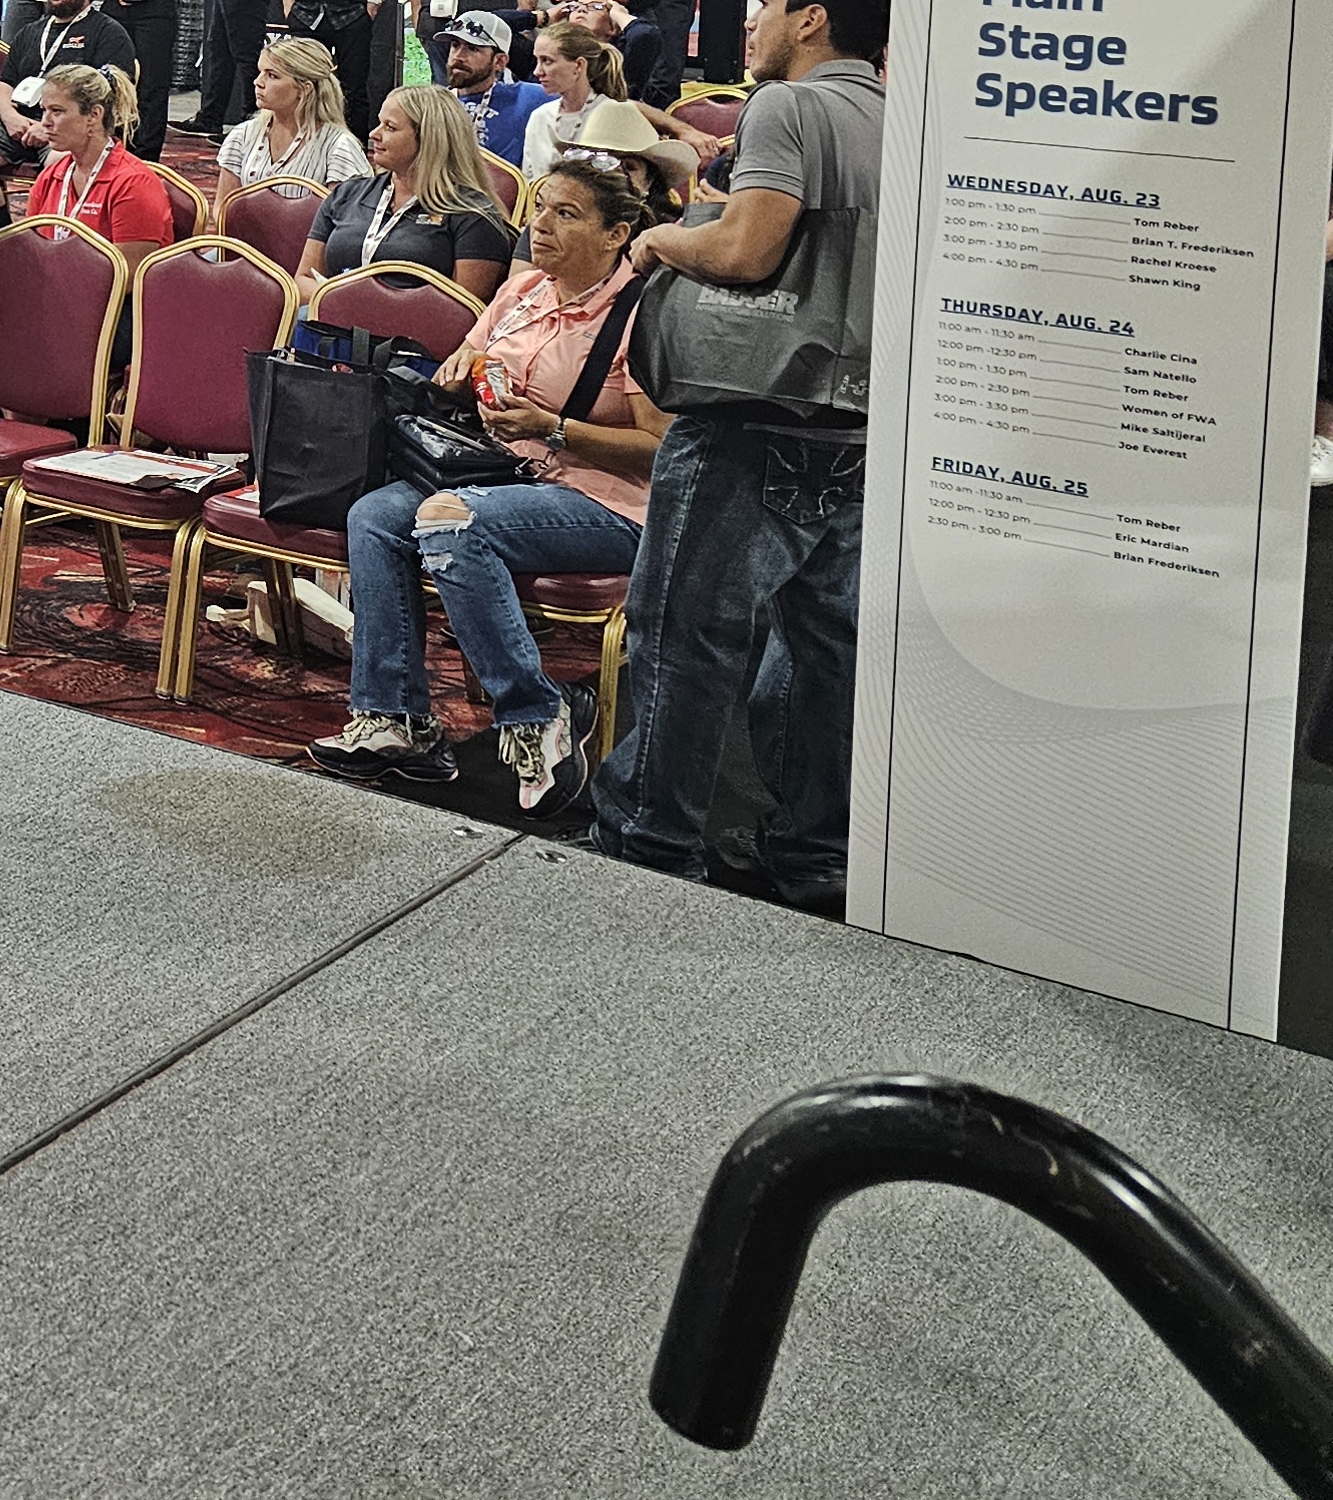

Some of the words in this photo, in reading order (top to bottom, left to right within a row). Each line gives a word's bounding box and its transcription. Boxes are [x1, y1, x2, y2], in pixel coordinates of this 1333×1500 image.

[977, 22, 1127, 71] Stage
[975, 72, 1219, 125] Speakers
[947, 174, 1074, 201] WEDNESDAY,
[1081, 188, 1129, 204] AUG.
[1136, 193, 1160, 207] 23
[944, 216, 966, 225] 2:00
[969, 220, 987, 228] pm
[997, 222, 1019, 231] 2:30
[1021, 226, 1039, 234] pm
[1132, 237, 1163, 247] Brian
[1167, 241, 1177, 249] T.
[1181, 242, 1254, 258] Frederiksen
[945, 197, 965, 206] 1:00
[968, 202, 986, 210] pm
[996, 203, 1015, 212] 1:30
[1018, 207, 1036, 215] pm
[1134, 218, 1160, 228] Tom
[1163, 221, 1199, 232] Reber
[942, 234, 965, 244] 3:00
[968, 238, 986, 247] pm
[996, 240, 1017, 249] 3:30
[1020, 244, 1038, 252] pm
[1131, 256, 1171, 267] Rachel
[1175, 261, 1217, 273] Kroese
[942, 252, 965, 261] 4:00
[968, 256, 986, 264] pm
[996, 258, 1018, 268] 4:30
[1021, 263, 1039, 271] pm
[1129, 275, 1169, 286] Shawn
[1173, 280, 1201, 292] King
[941, 298, 1048, 326] THURSDAY,
[1055, 313, 1102, 331] AUG.
[1109, 320, 1134, 335] 24
[937, 339, 963, 350] 12:00
[966, 344, 984, 353] pm
[1019, 352, 1037, 361] pm
[1124, 366, 1149, 377] Sam
[1153, 370, 1197, 384] Natello
[938, 321, 962, 331] 11:00
[964, 326, 982, 334] am
[991, 328, 1014, 339] 11:30
[1018, 333, 1035, 341] am
[1124, 347, 1167, 361] Charlie
[1170, 354, 1197, 365] Cina
[935, 375, 957, 385] 2:00
[960, 380, 978, 389] pm
[987, 383, 1009, 394] 2:30
[1012, 388, 1030, 397] pm
[1122, 404, 1168, 418] Women
[1171, 412, 1183, 420] of
[1187, 414, 1217, 426] FWA
[936, 357, 956, 367] 1:00
[959, 362, 977, 371] pm
[986, 364, 1006, 375] 1:30
[1009, 369, 1027, 378] pm
[1123, 385, 1149, 396] Tom
[1153, 389, 1188, 402] Reber
[933, 411, 956, 422] 4:00
[959, 416, 977, 425] pm
[986, 419, 1009, 430] 4:30
[1012, 424, 1030, 434] pm
[1118, 441, 1139, 451] Joe
[1143, 445, 1188, 460] Everest
[934, 393, 956, 403] 3:00
[959, 398, 977, 407] pm
[986, 401, 1008, 412] 3:30
[1011, 406, 1029, 415] pm
[1120, 422, 1149, 434] Mike
[1152, 427, 1206, 443] Saltijeral
[932, 456, 1005, 483] FRIDAY,
[1011, 470, 1057, 490] AUG.
[1063, 479, 1088, 495] 25
[929, 480, 953, 491] 11:00
[955, 485, 973, 495] am
[1005, 494, 1023, 504] am
[1116, 513, 1142, 525] Tom
[1146, 518, 1181, 533] Reber
[929, 497, 954, 509] 12:00
[957, 503, 975, 514] pm
[984, 508, 1010, 520] 12:30
[1012, 514, 1031, 524] pm
[1115, 532, 1137, 544] Eric
[1140, 536, 1190, 553] Mardian
[927, 515, 949, 526] 2:30
[951, 521, 969, 531] pm
[978, 525, 1001, 536] 3:00
[1004, 531, 1022, 541] pm
[1113, 551, 1144, 564] Brian
[1148, 557, 1220, 579] Frederiksen
